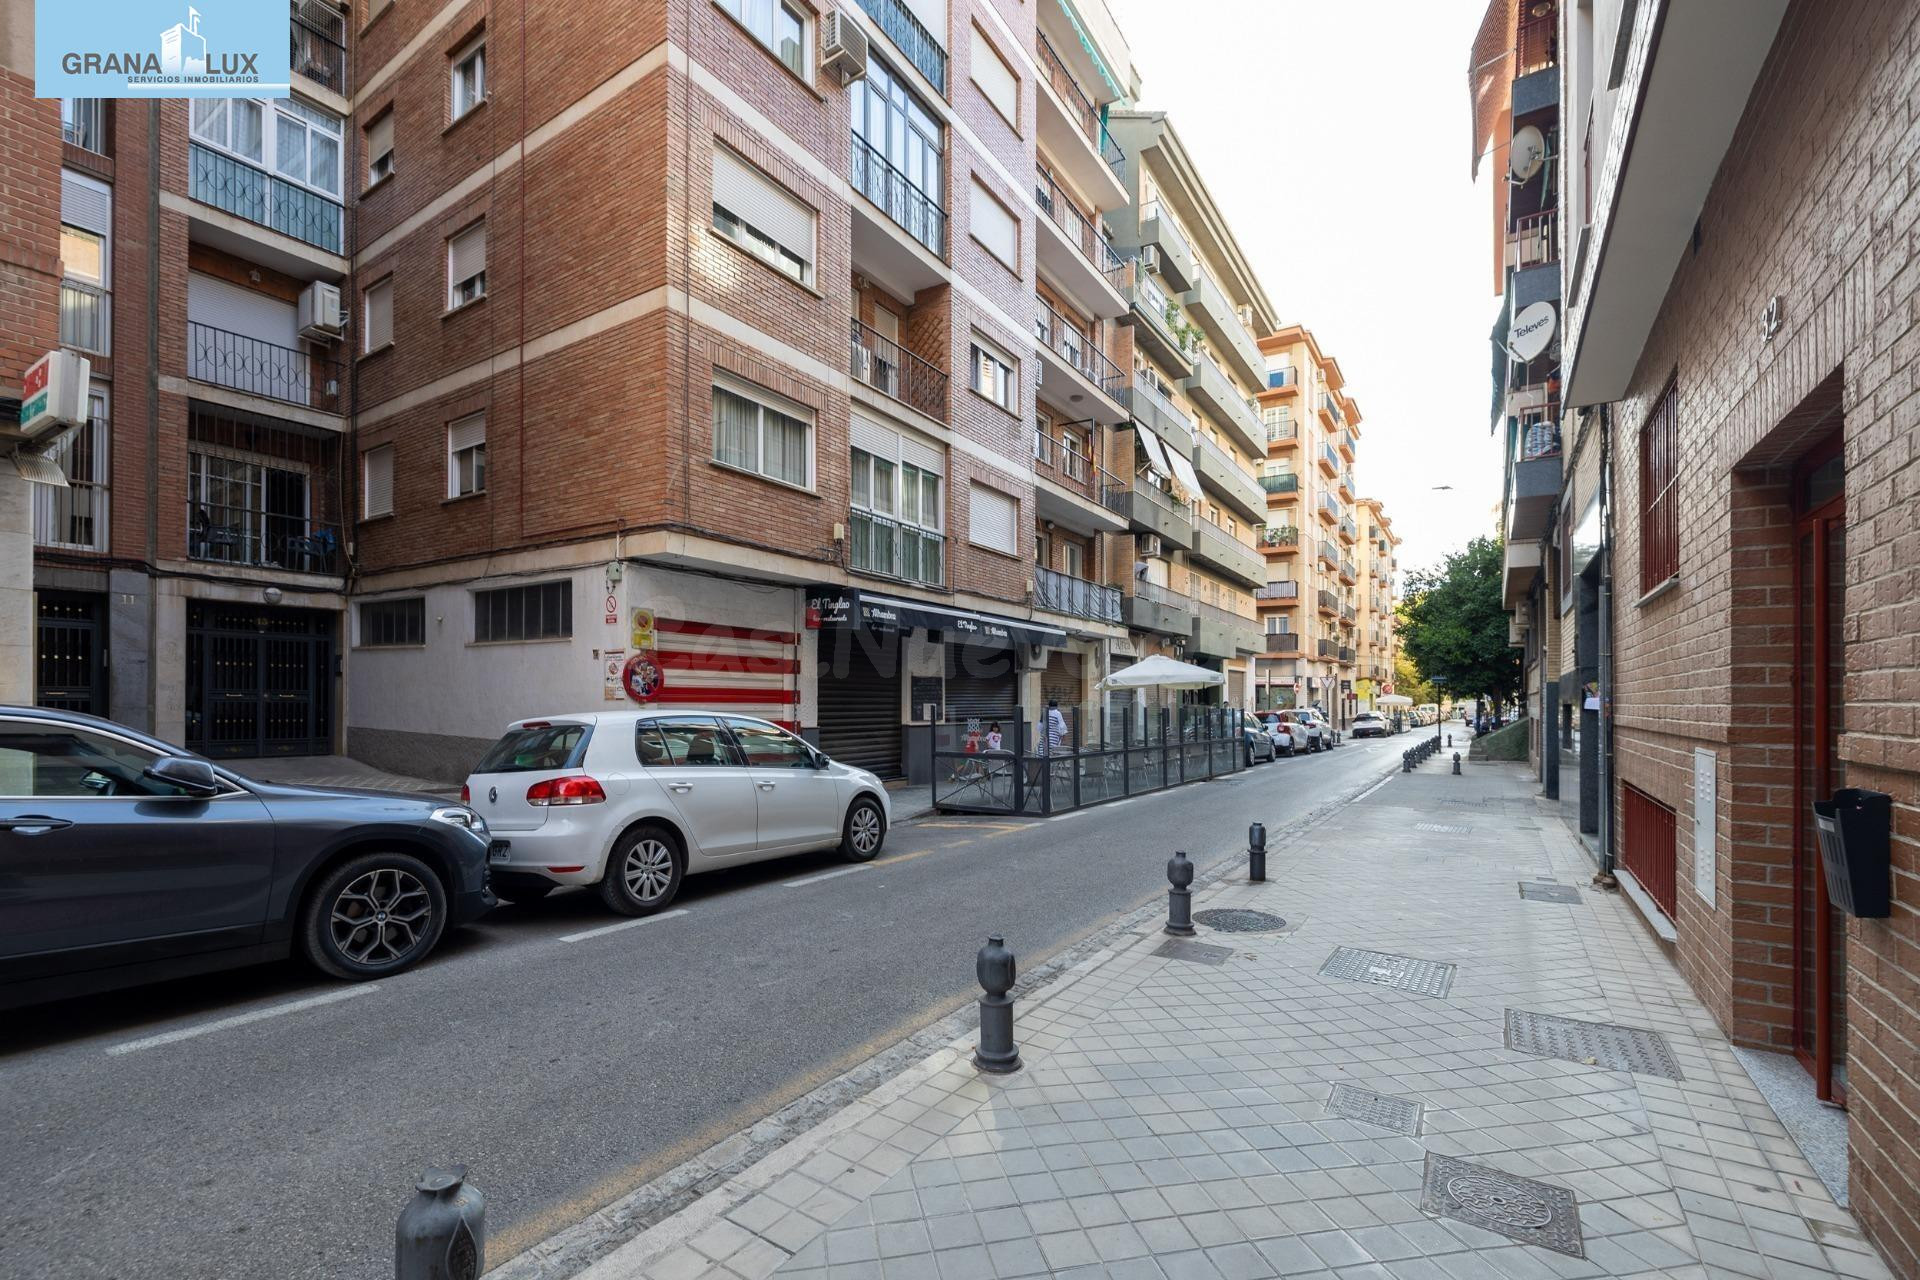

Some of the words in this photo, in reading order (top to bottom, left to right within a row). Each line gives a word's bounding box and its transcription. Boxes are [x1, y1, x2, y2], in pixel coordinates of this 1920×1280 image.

[1514, 314, 1550, 339] Televes
[1761, 296, 1778, 342] 32
[811, 597, 822, 610] El
[822, 596, 850, 614] Tinglao
[871, 608, 897, 621] Alhambra
